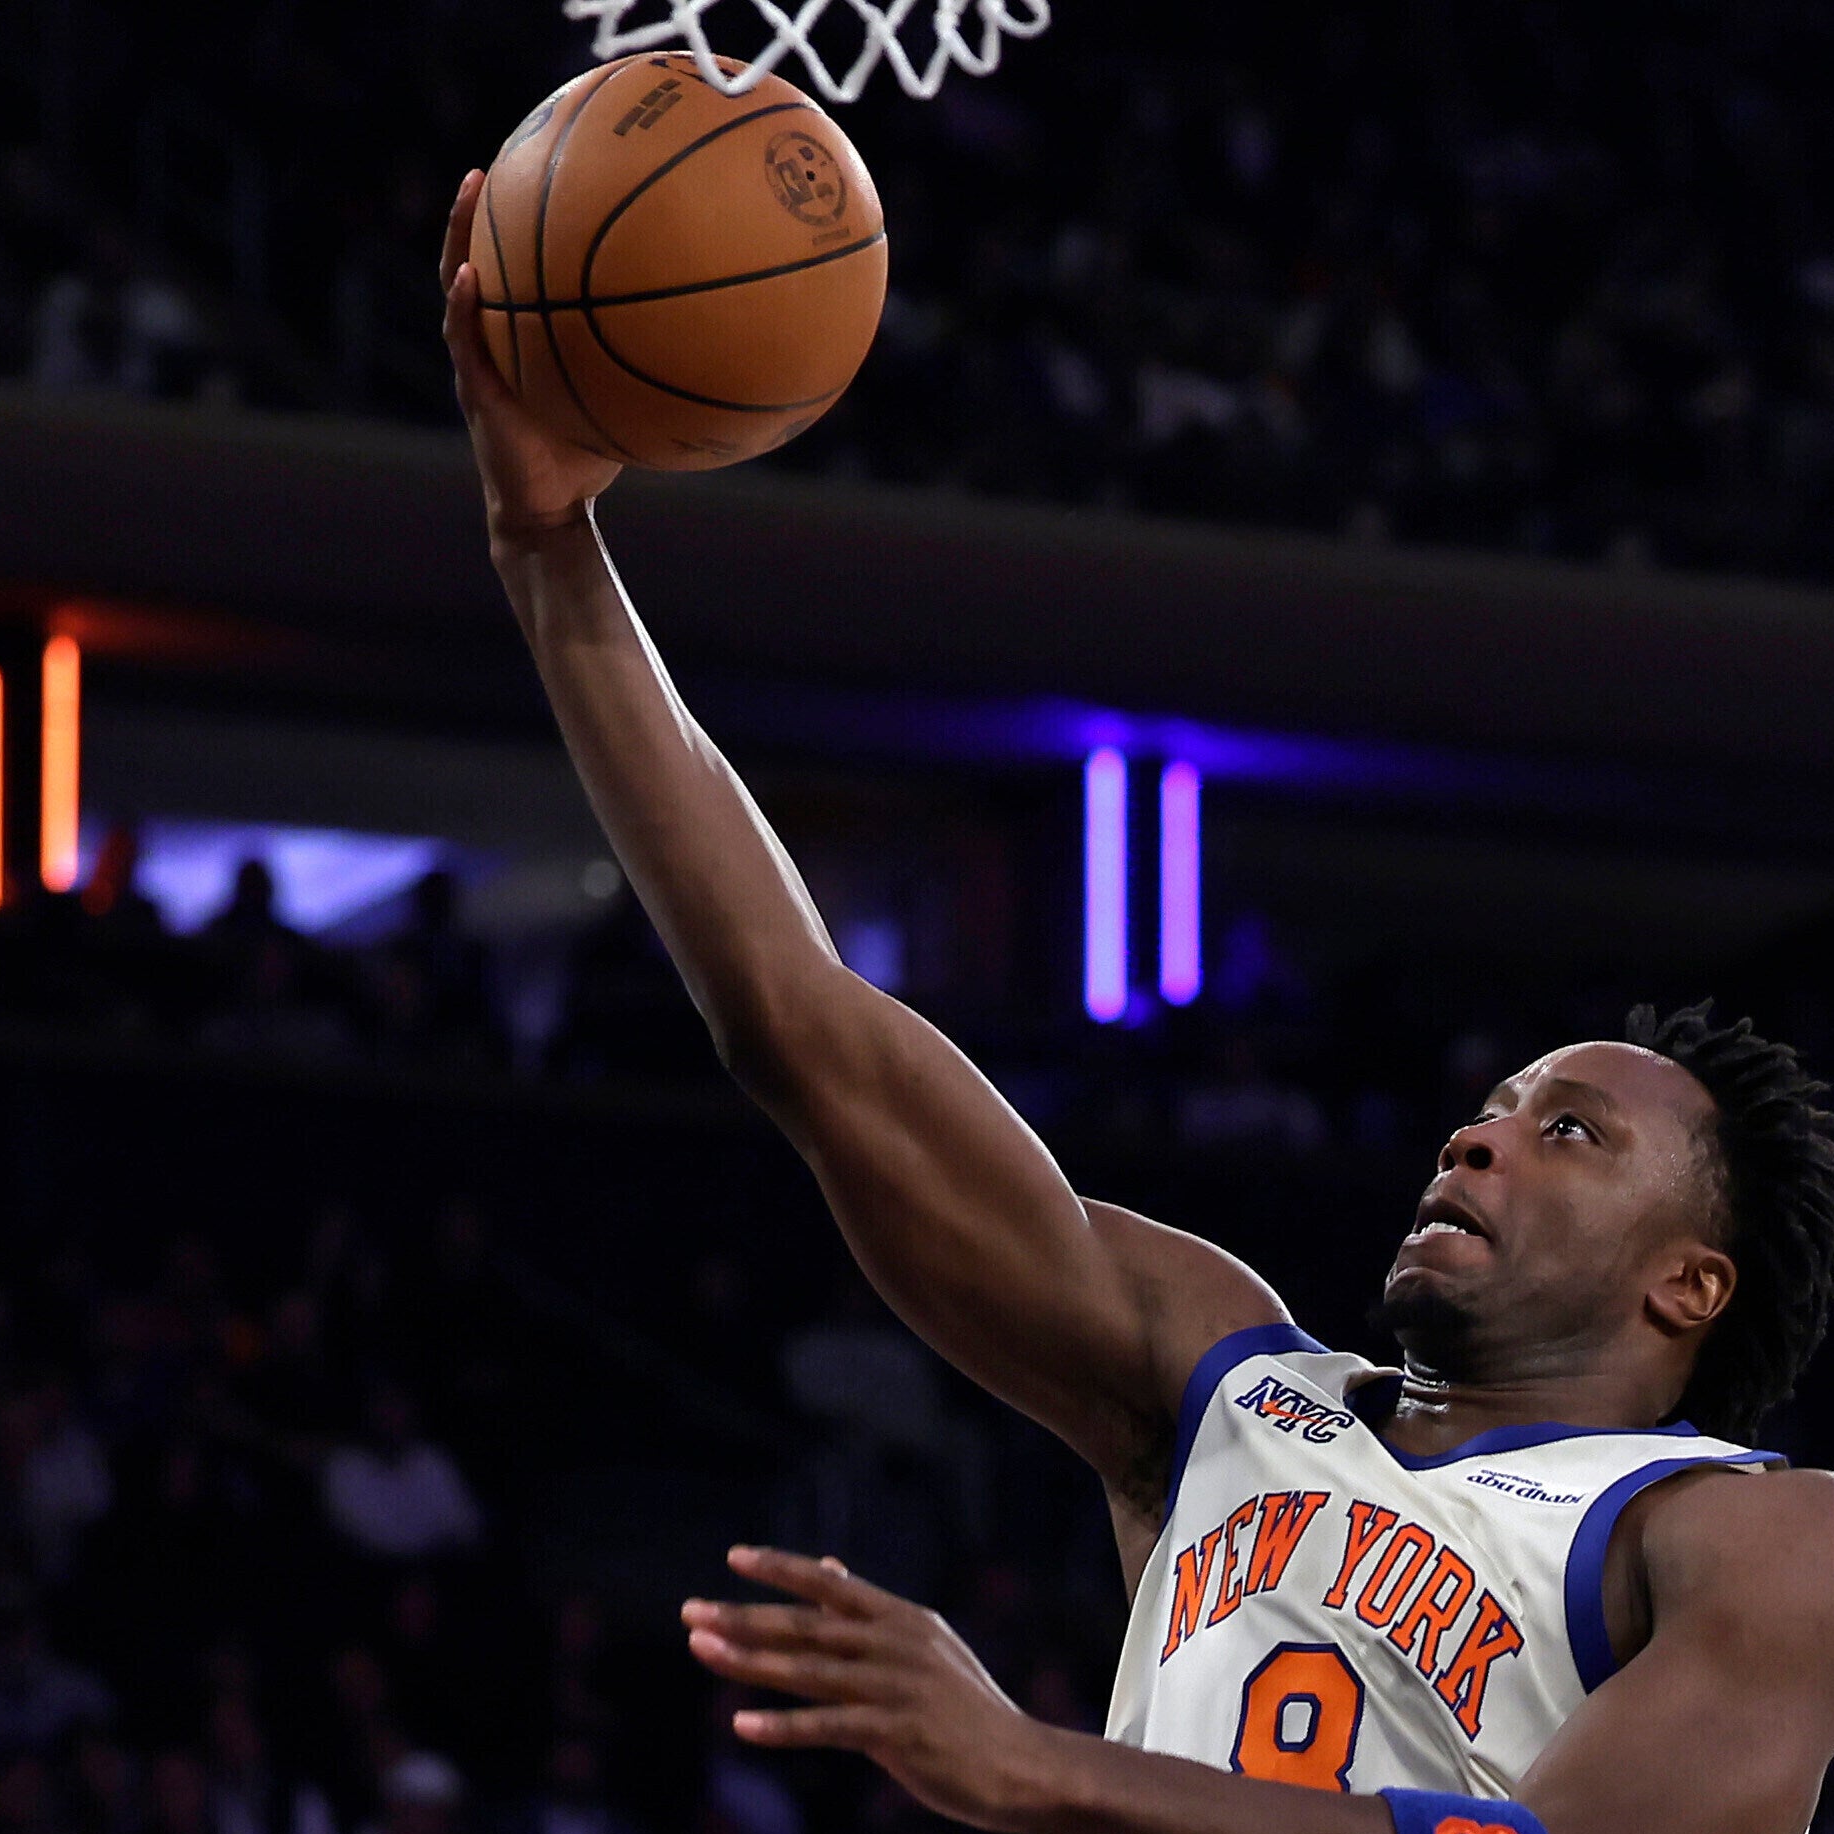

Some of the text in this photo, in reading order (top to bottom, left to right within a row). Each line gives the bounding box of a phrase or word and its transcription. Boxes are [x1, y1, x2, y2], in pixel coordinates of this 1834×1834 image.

[1234, 1375, 1355, 1443] NYC
[1467, 1475, 1588, 1504] abu dhabi
[1160, 1489, 1525, 1743] NEW YORK
